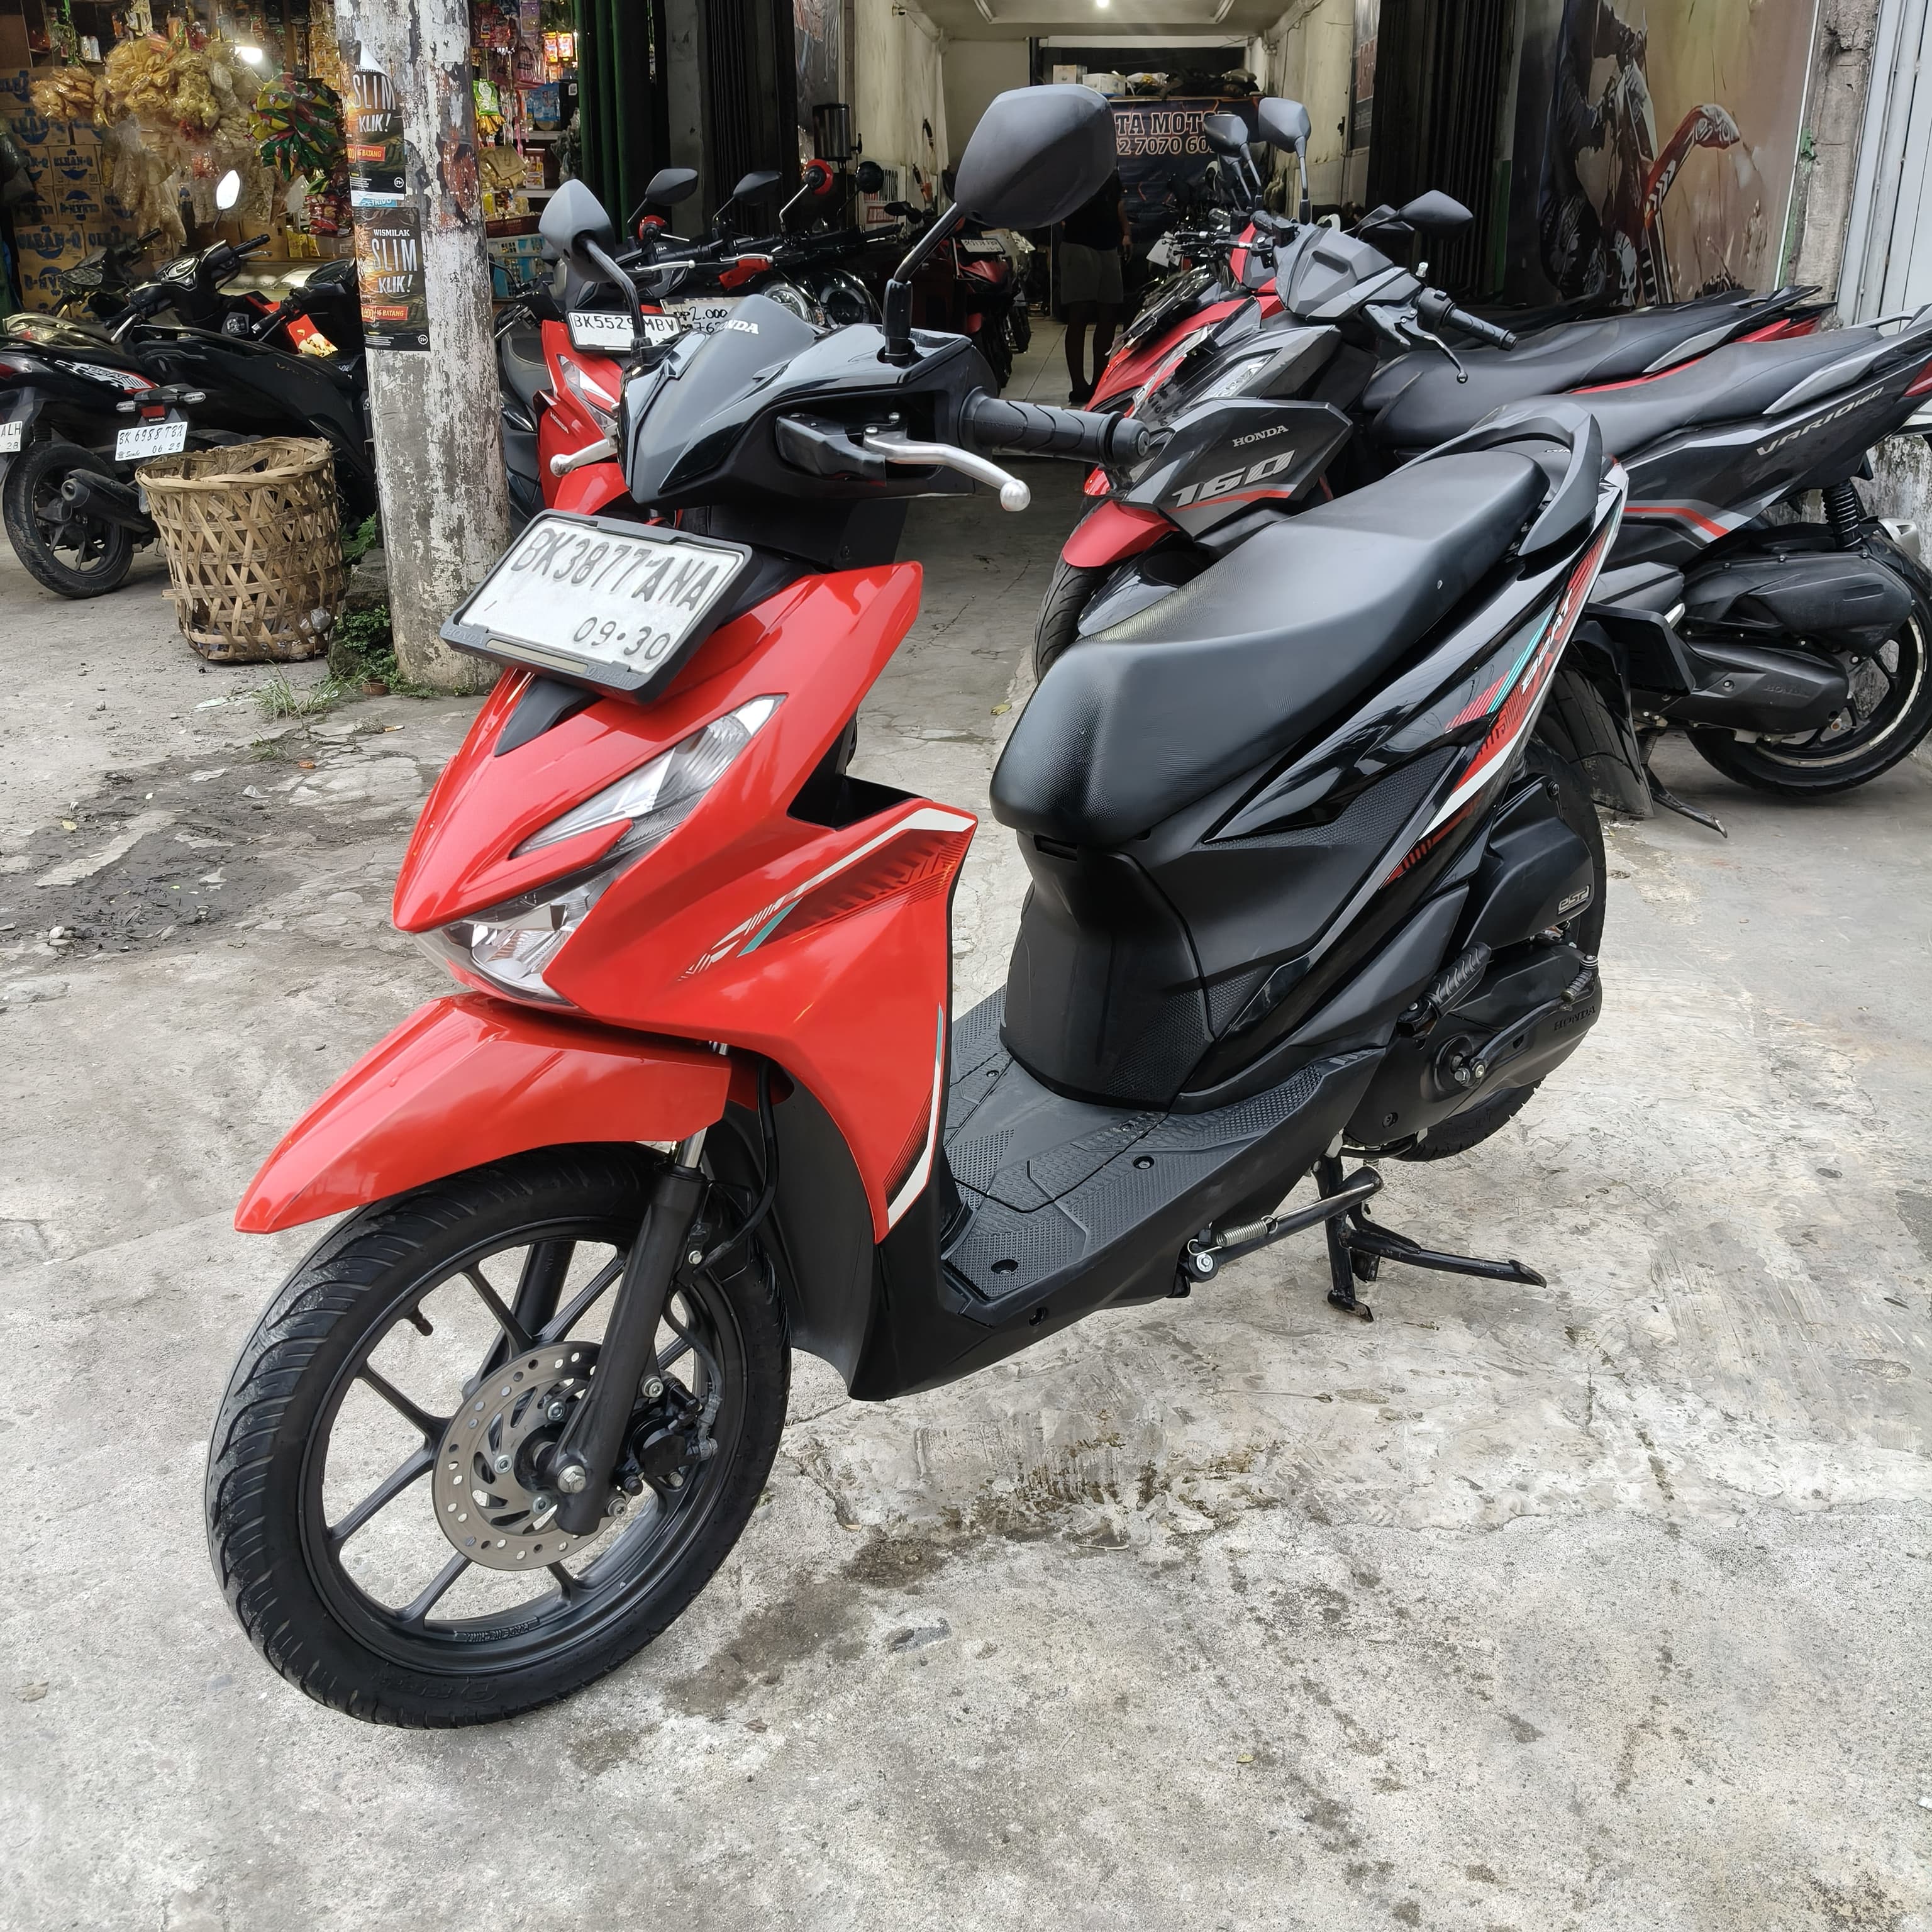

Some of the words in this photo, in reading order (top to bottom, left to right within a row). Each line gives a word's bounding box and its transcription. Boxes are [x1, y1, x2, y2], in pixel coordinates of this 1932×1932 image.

[352, 74, 396, 110] SLIM
[358, 113, 392, 133] KLIK!
[1135, 136, 1182, 155] 7070
[373, 229, 411, 237] WISMILAK
[371, 238, 418, 272] SLIM
[378, 275, 413, 294] KLIK!
[1232, 425, 1289, 447] HONDA
[1172, 450, 1295, 508] 160
[445, 629, 484, 645] HONDA
[1553, 1006, 1596, 1032] HONDA
